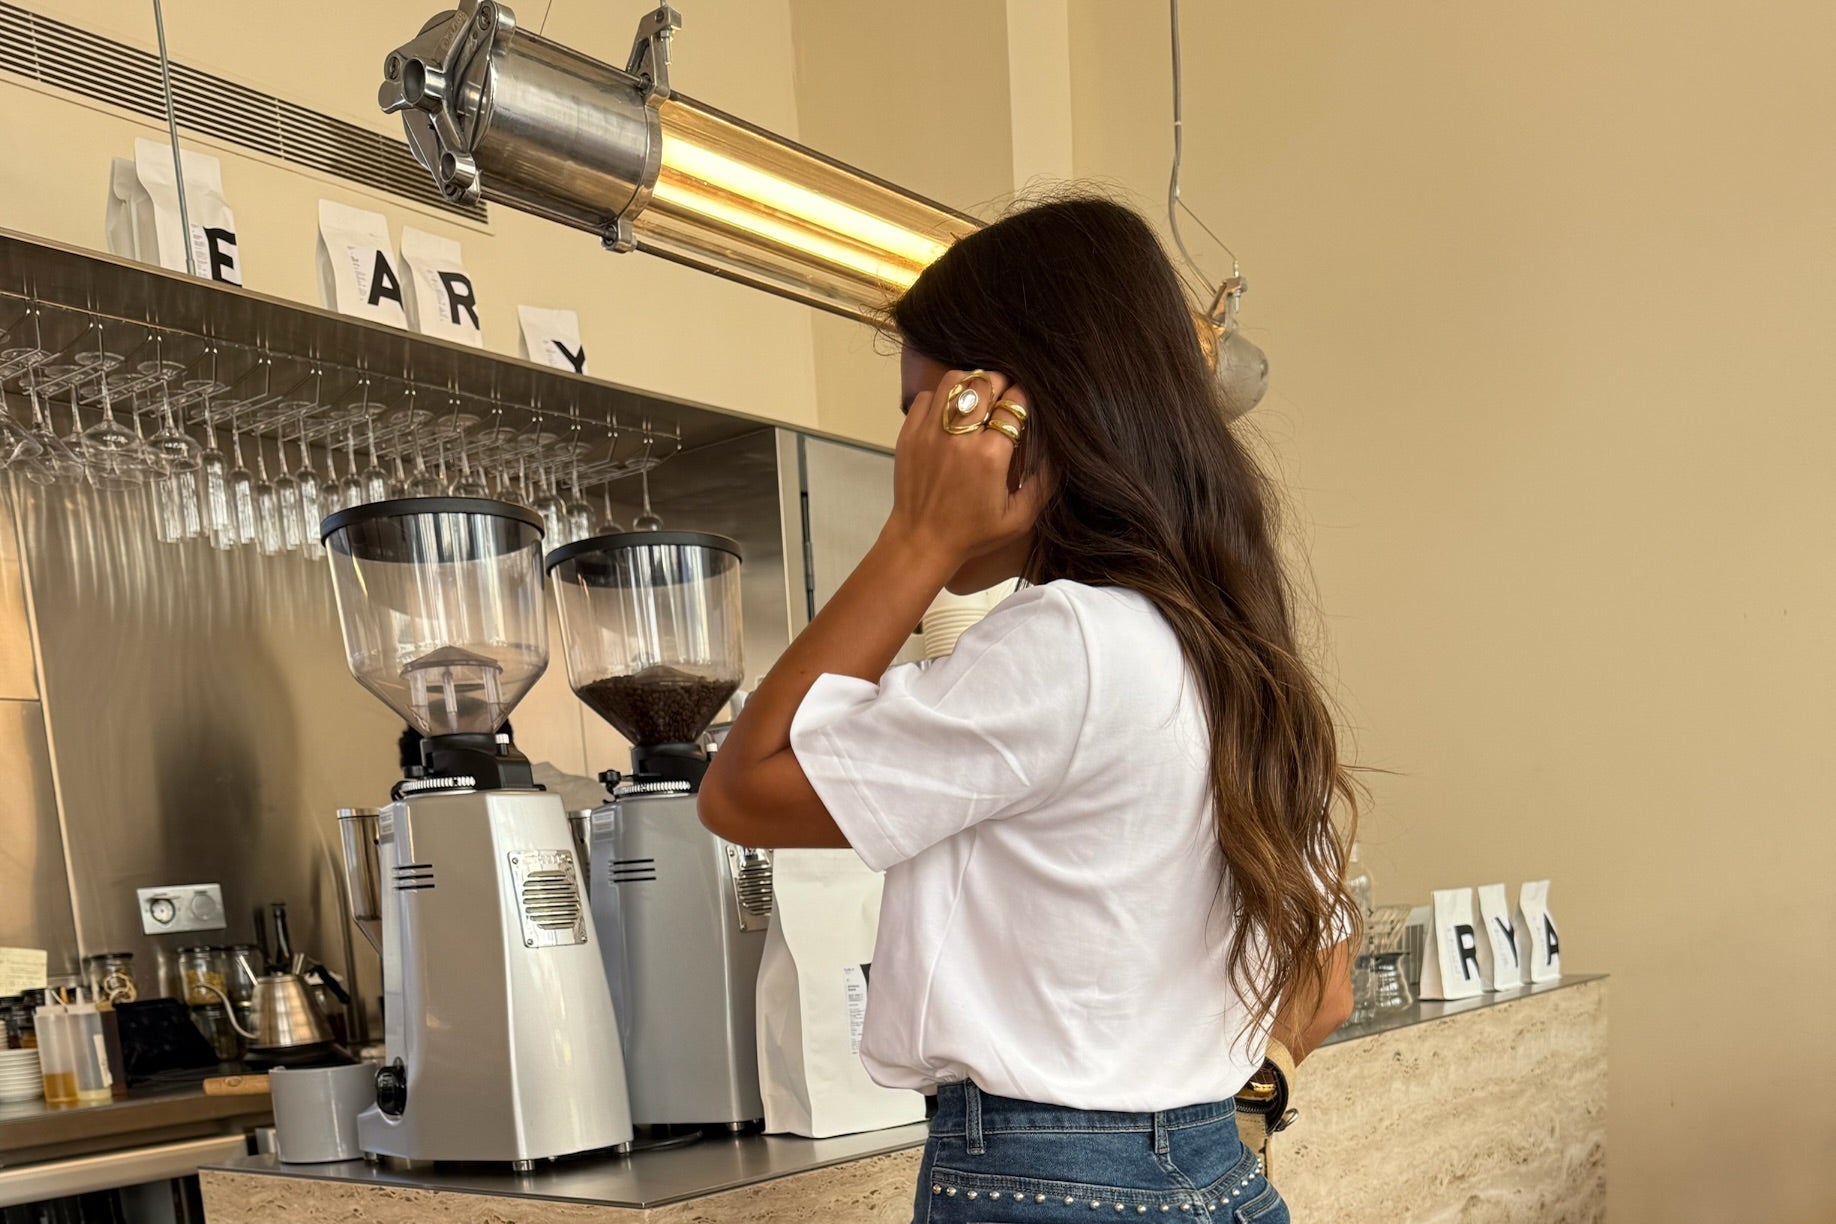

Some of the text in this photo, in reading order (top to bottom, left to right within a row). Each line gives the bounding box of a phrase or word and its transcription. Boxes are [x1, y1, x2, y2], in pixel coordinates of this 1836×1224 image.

[203, 227, 242, 288] E
[368, 250, 404, 312] A
[438, 271, 480, 330] R
[551, 339, 586, 374] Y
[1455, 924, 1479, 980] R
[1495, 917, 1518, 968] Y
[1544, 914, 1559, 965] A
